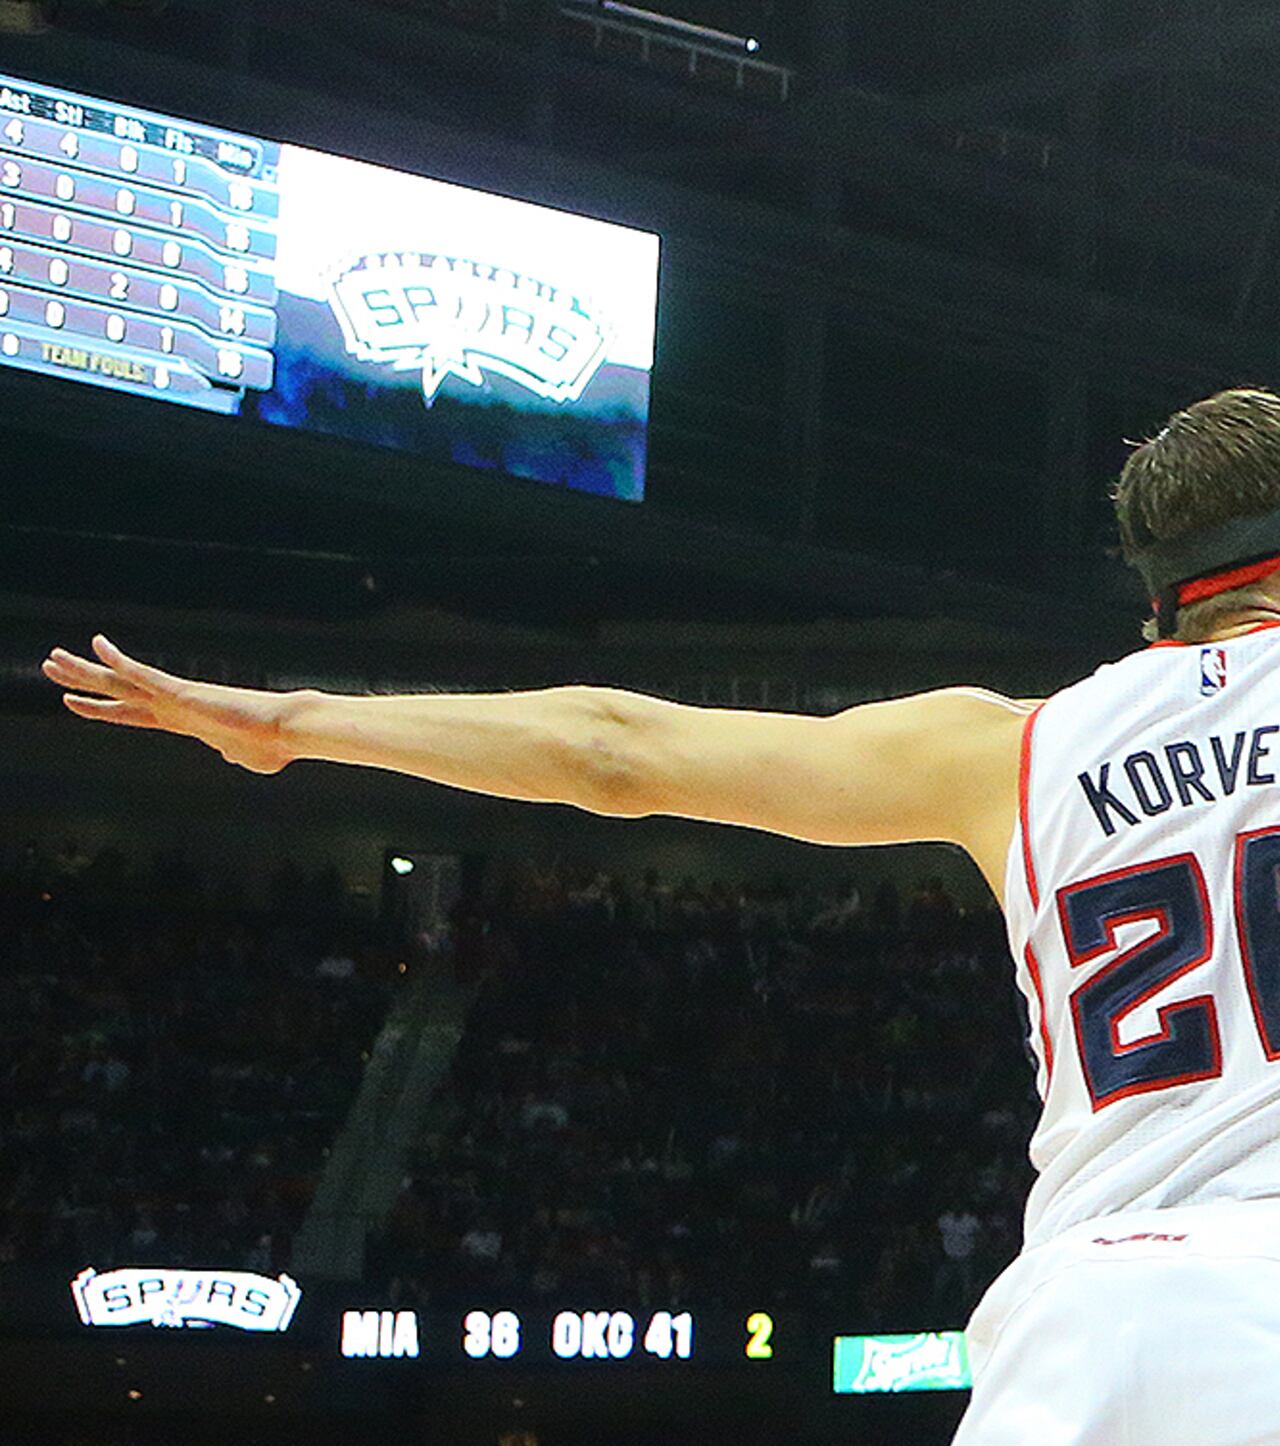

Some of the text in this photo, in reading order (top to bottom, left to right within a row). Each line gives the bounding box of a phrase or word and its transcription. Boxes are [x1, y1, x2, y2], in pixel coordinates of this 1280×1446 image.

[4, 118, 24, 146] 4
[59, 131, 79, 160] 4
[119, 145, 138, 174] 0
[171, 157, 186, 186] 1
[1, 160, 22, 188] 3
[55, 173, 75, 201] 0
[115, 187, 135, 217] 0
[170, 200, 183, 229] 1
[1, 202, 16, 231] 1
[52, 213, 72, 243] 0
[112, 229, 132, 257] 0
[162, 240, 182, 268] 0
[49, 257, 69, 287] 0
[109, 271, 129, 301] 2
[158, 283, 179, 312] 0
[45, 300, 66, 330] 0
[105, 314, 126, 343] 0
[160, 326, 175, 355] 1
[361, 285, 578, 362] SPURS
[42, 344, 88, 371] TEAM
[91, 356, 147, 384] FOULS
[102, 1277, 271, 1318] SPURS
[341, 1310, 420, 1358] MIA
[552, 1310, 635, 1359] OKC
[643, 1310, 694, 1359] 41
[745, 1312, 774, 1359] 2
